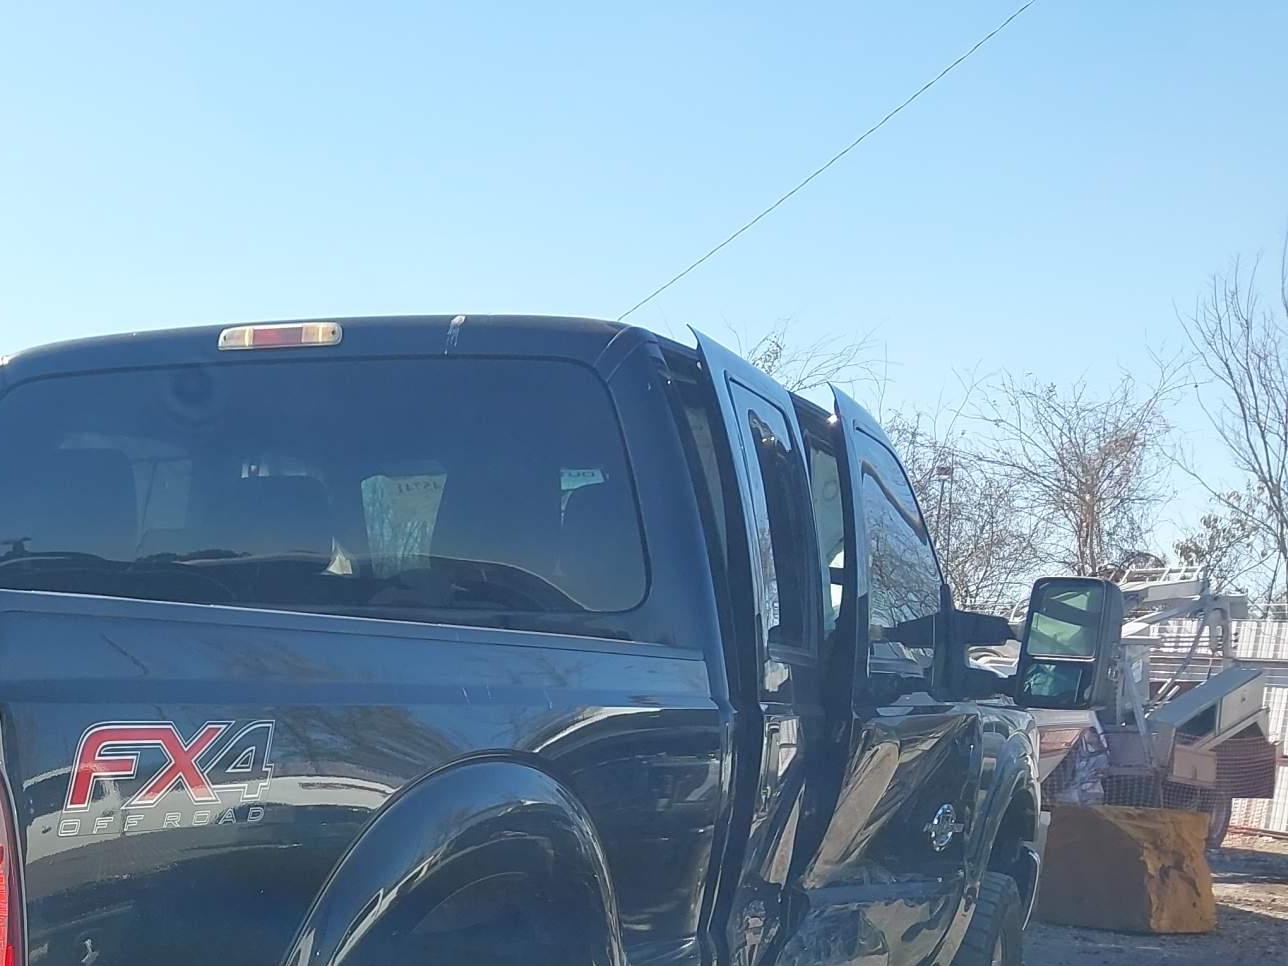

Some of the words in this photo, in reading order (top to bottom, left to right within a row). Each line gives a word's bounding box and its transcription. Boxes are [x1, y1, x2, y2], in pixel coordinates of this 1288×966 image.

[62, 719, 276, 812] FX4
[58, 814, 145, 837] OFF
[162, 807, 266, 829] ROAD
